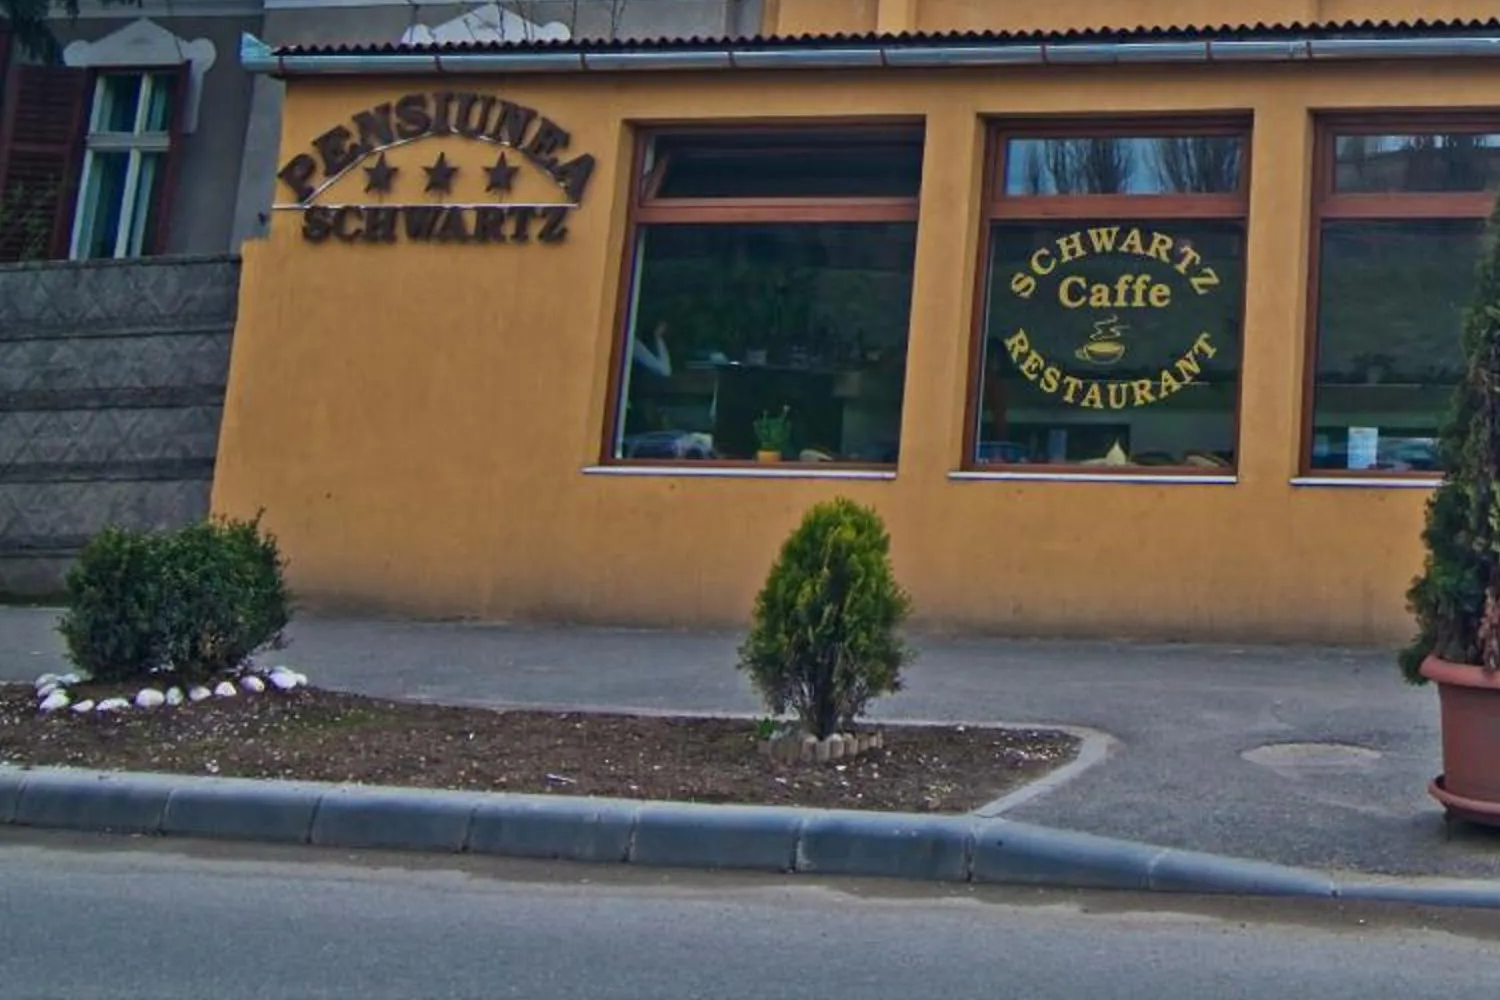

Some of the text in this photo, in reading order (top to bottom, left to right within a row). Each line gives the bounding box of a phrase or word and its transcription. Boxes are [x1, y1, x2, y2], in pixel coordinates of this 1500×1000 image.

[276, 91, 597, 201] PENSIUNEA
[301, 204, 569, 244] SCHWARTZ
[1010, 226, 1220, 299] SCHWARTZ
[1058, 274, 1172, 308] Caffe
[1004, 328, 1218, 410] RESTAURANT
